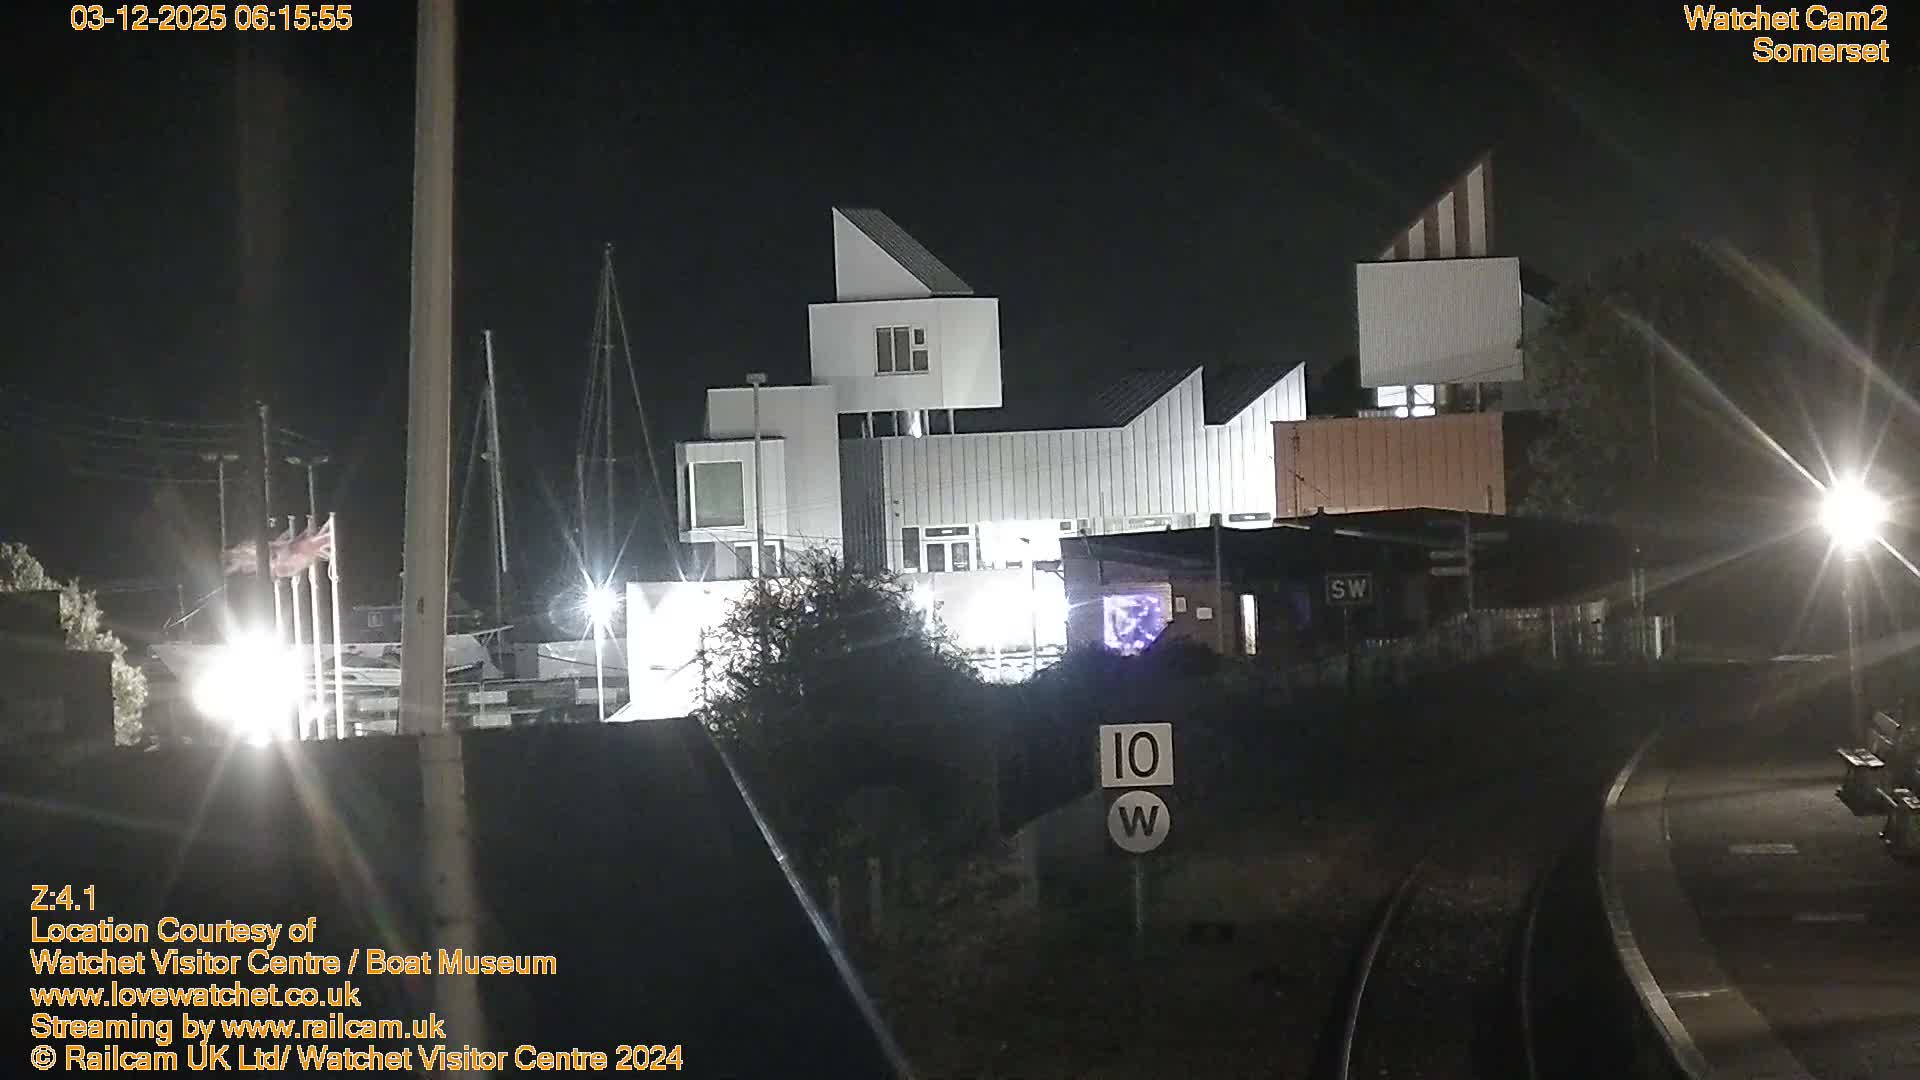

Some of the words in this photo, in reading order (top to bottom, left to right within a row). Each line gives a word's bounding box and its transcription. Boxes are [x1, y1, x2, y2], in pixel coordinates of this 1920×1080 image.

[1331, 579, 1367, 600] SW
[1114, 731, 1160, 779] 10
[1118, 804, 1160, 838] W
